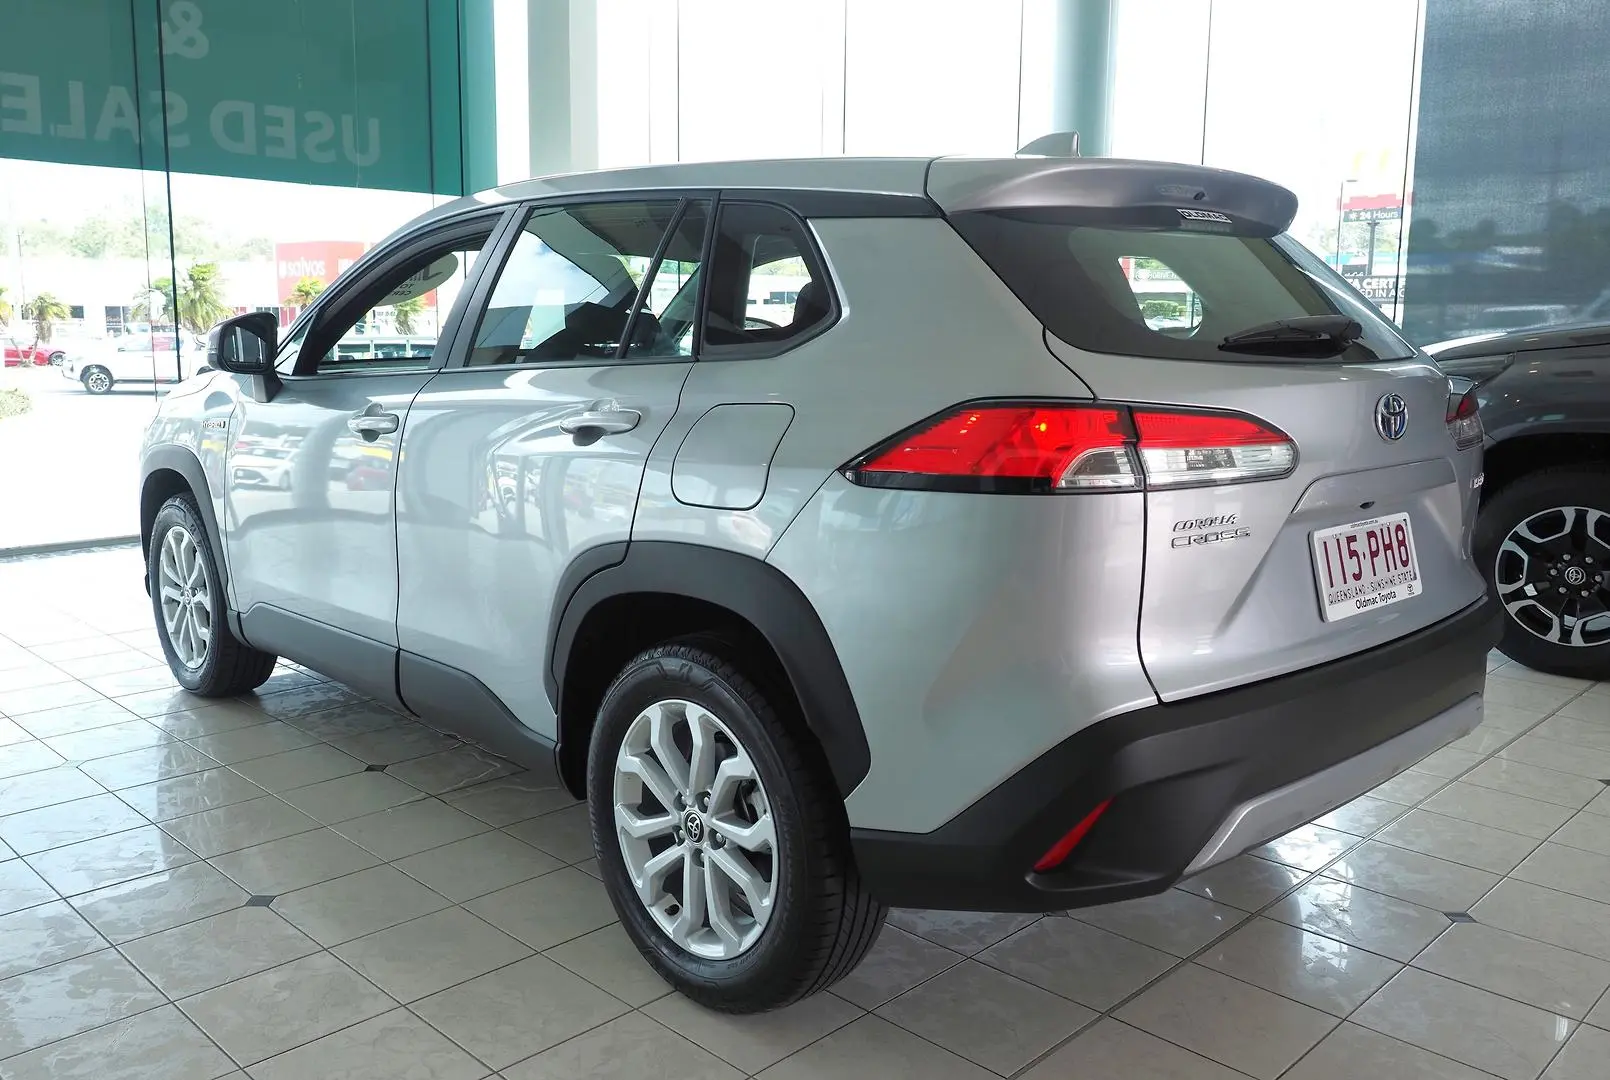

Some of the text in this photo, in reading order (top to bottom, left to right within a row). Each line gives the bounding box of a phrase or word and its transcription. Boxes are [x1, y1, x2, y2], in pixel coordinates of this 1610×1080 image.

[1360, 209, 1399, 220] 24 Hours
[288, 257, 326, 277] salvos
[1375, 289, 1386, 297] IN
[1172, 513, 1238, 532] COROLLA
[1170, 527, 1251, 549] CROSS
[1328, 584, 1366, 604] QUEENSLAND
[1398, 571, 1413, 584] STATE
[1355, 590, 1397, 610] Oldmac Toyota
